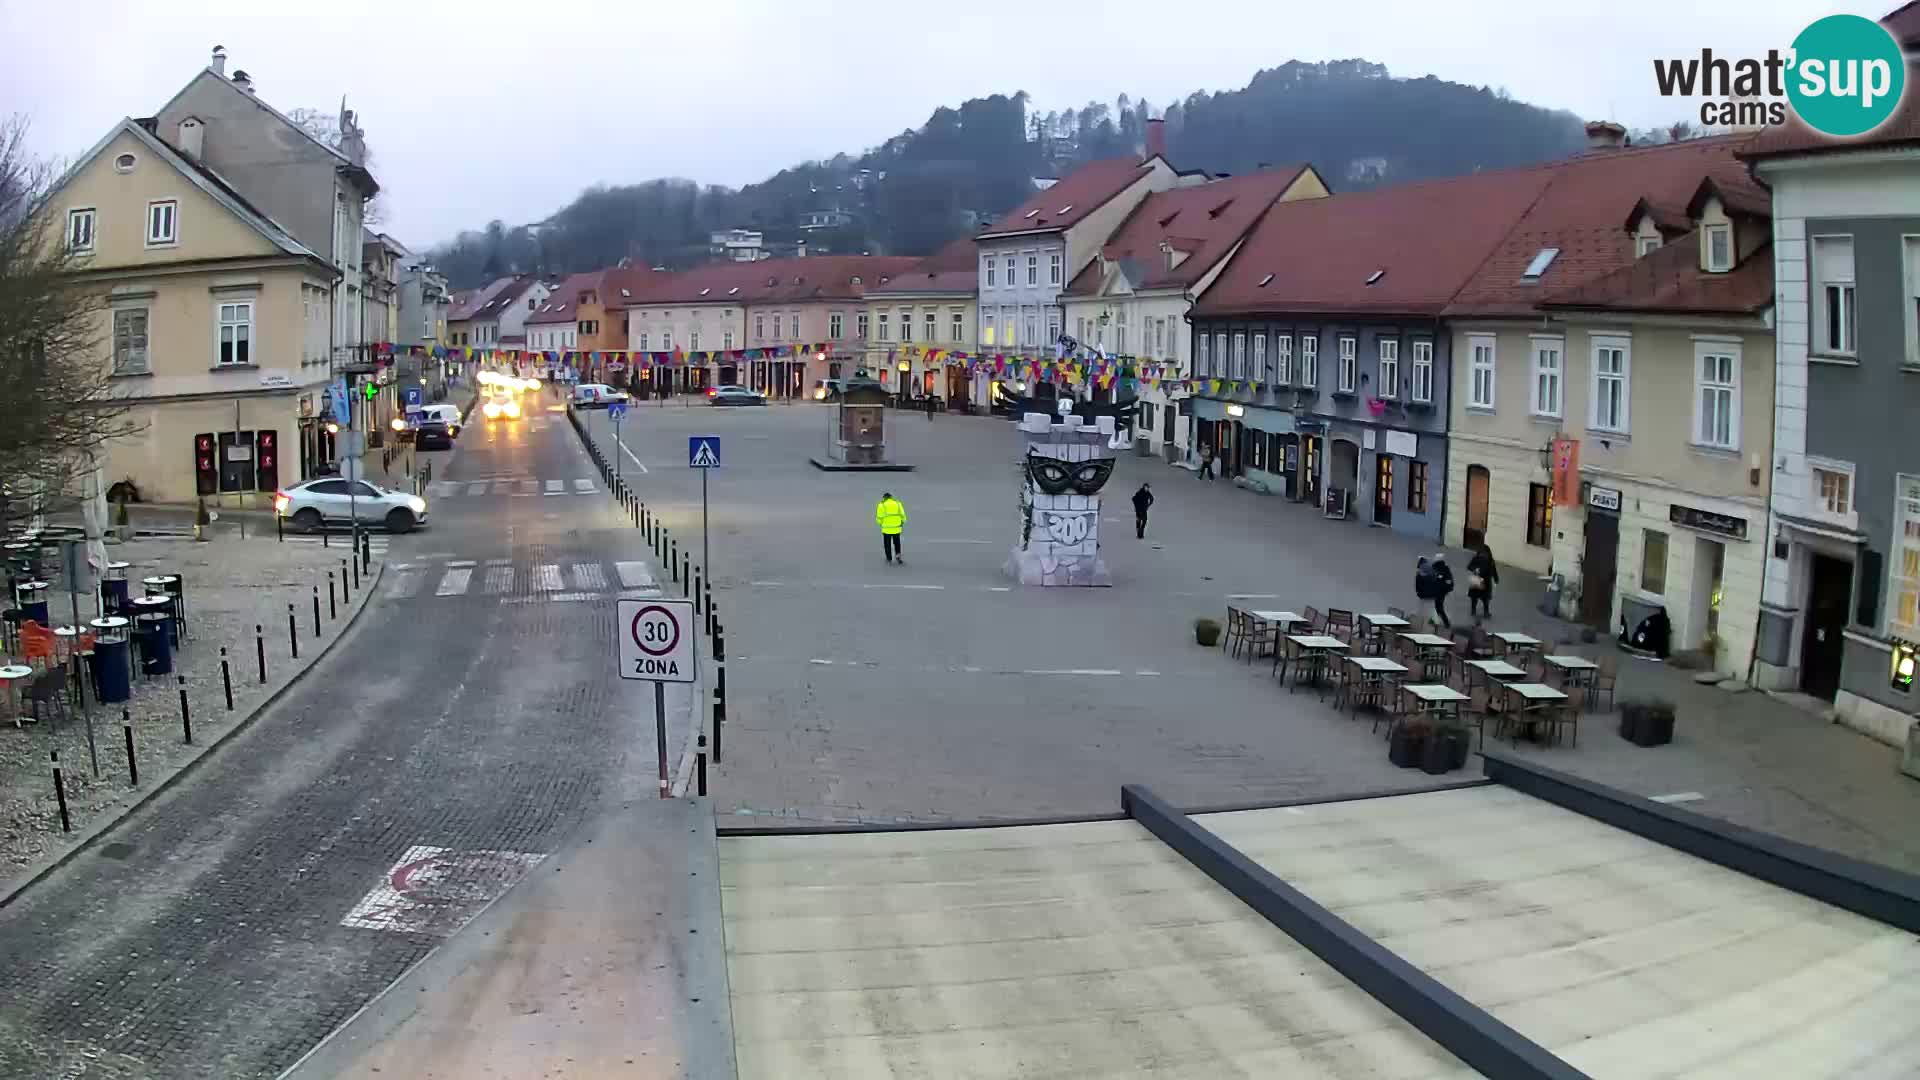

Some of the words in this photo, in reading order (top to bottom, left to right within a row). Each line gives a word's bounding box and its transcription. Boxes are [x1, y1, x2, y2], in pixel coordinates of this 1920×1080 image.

[1048, 515, 1088, 544] 200
[644, 621, 668, 642] 30
[635, 658, 679, 675] ZONA
